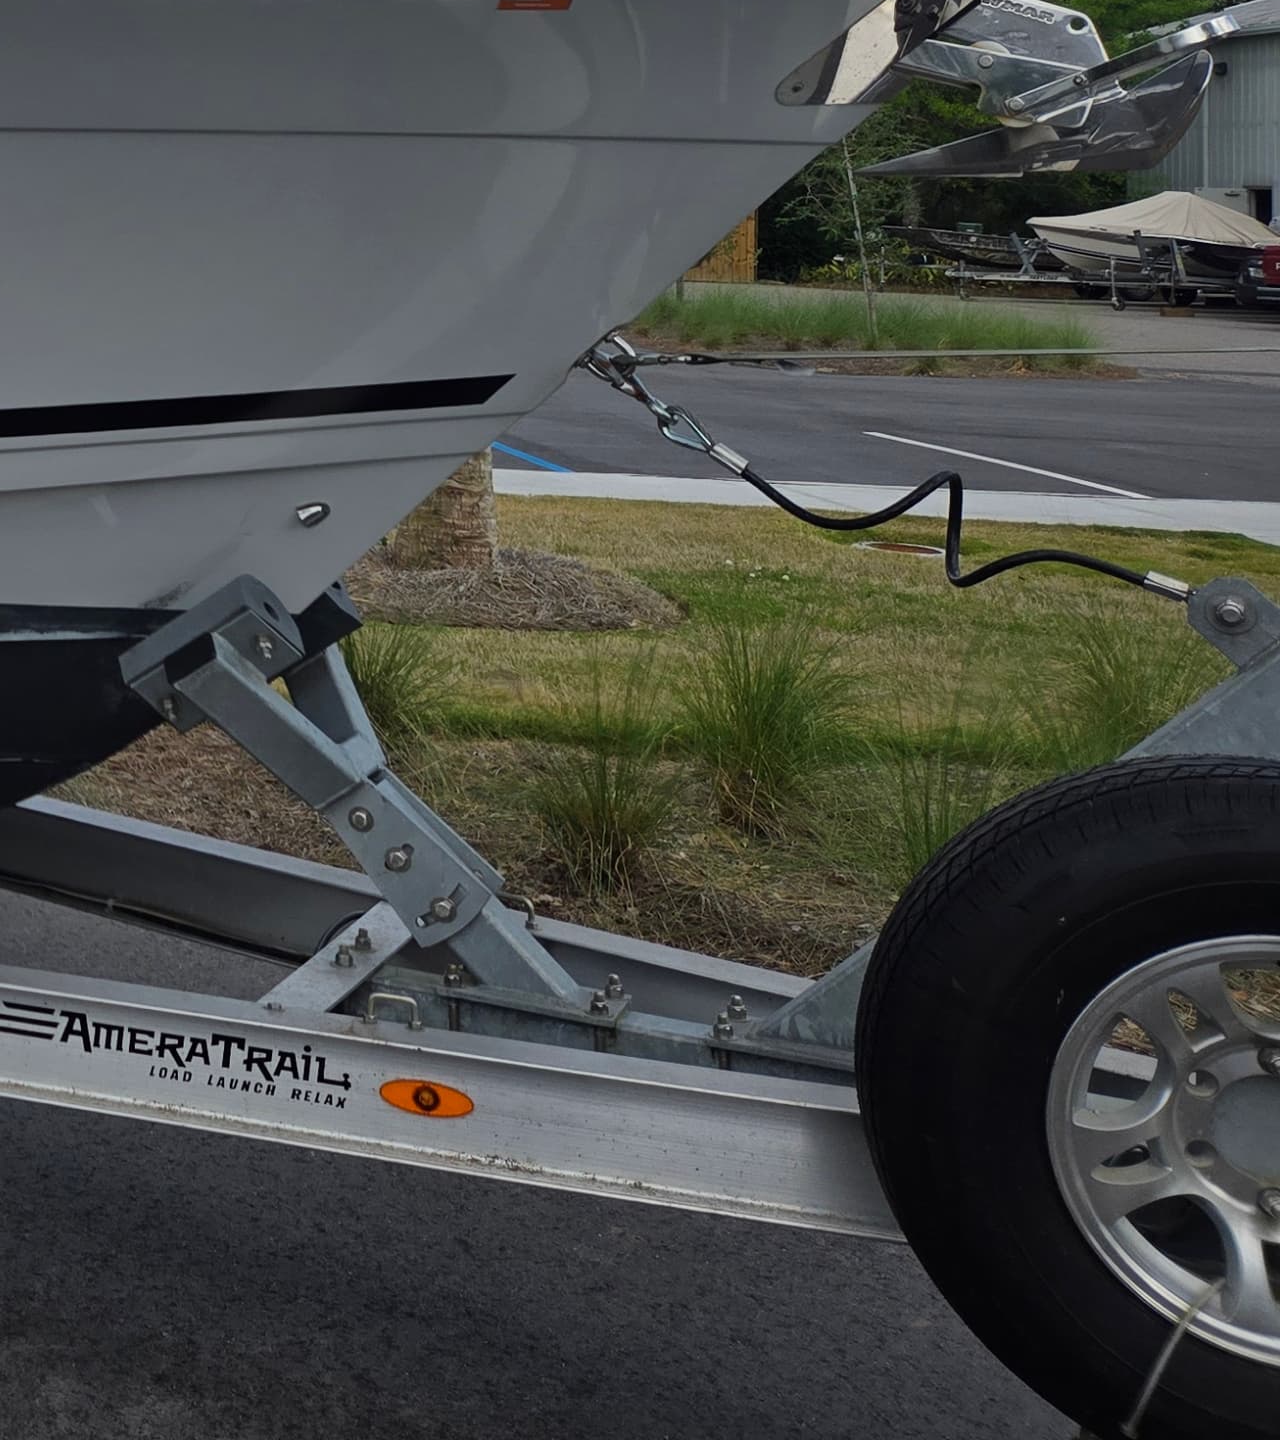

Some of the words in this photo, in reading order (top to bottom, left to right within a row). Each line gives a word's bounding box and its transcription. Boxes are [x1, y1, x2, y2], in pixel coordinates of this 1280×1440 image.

[149, 1065, 193, 1083] LOAD
[207, 1074, 276, 1097] LAUNCH
[291, 1087, 348, 1109] RELAX
